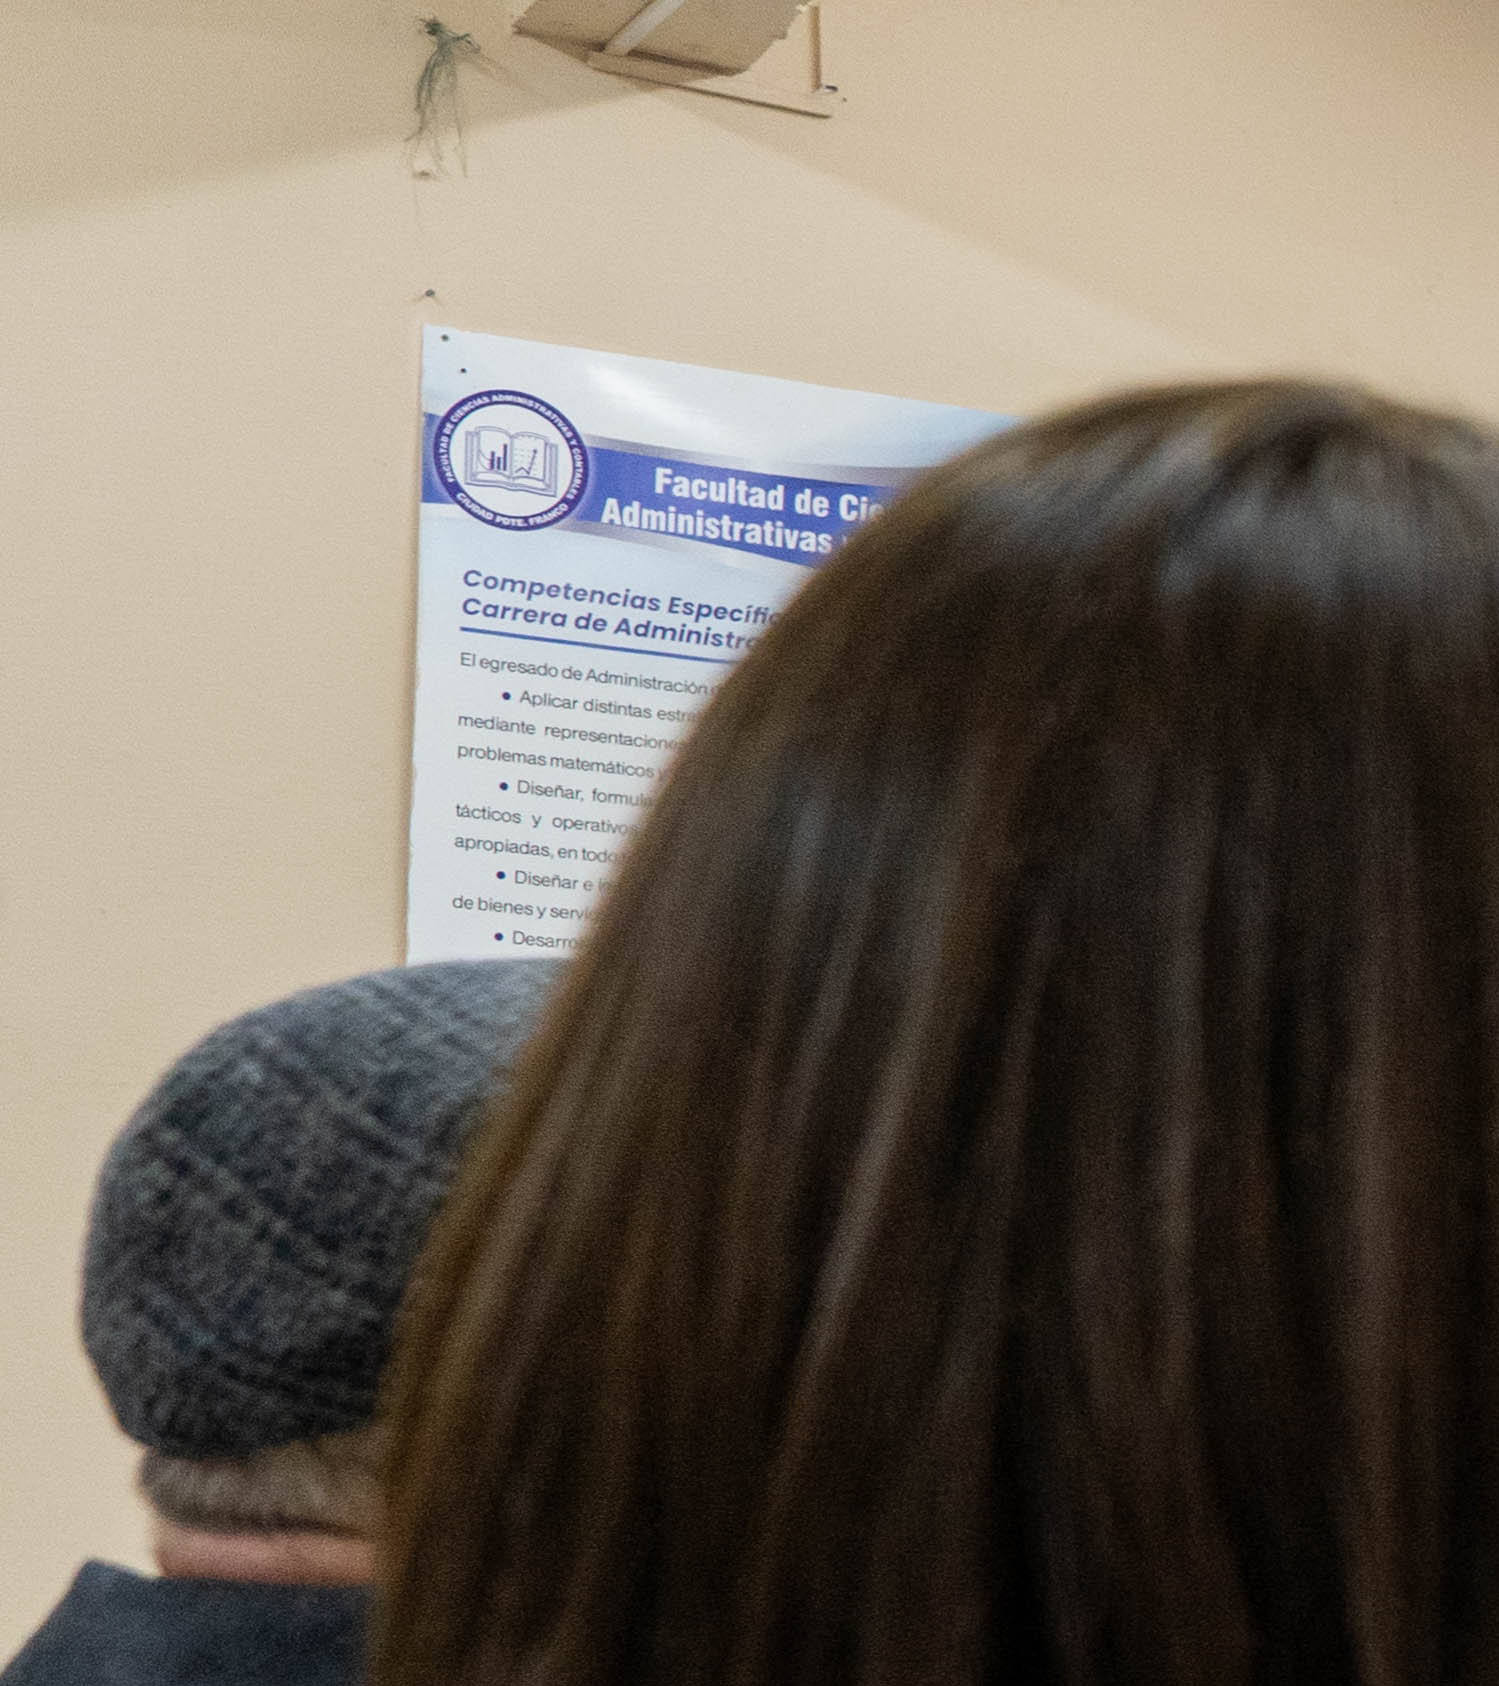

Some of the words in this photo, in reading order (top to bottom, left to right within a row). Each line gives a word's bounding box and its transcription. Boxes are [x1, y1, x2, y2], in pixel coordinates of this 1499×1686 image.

[654, 467, 785, 511] Facultad
[794, 489, 830, 518] de
[601, 498, 833, 553] Administrativas
[463, 570, 661, 612] Competencias
[462, 598, 567, 627] Carrera
[574, 612, 608, 632] de
[459, 652, 476, 667] El
[479, 656, 558, 678] egresado
[561, 663, 583, 681] de
[586, 668, 708, 697] Administración
[519, 690, 578, 711] Aplicar
[584, 698, 652, 720] distintas
[458, 713, 536, 735] mediante
[457, 743, 546, 767] problemas
[549, 753, 655, 779] matemáticos
[517, 780, 585, 802] Diseñar,
[455, 804, 522, 824] tácticos
[531, 814, 542, 828] y
[454, 836, 554, 860] apropiadas,
[557, 846, 578, 860] en
[514, 870, 579, 890] Diseñar
[452, 894, 474, 911] de
[478, 897, 534, 917] bienes
[536, 904, 547, 919] y
